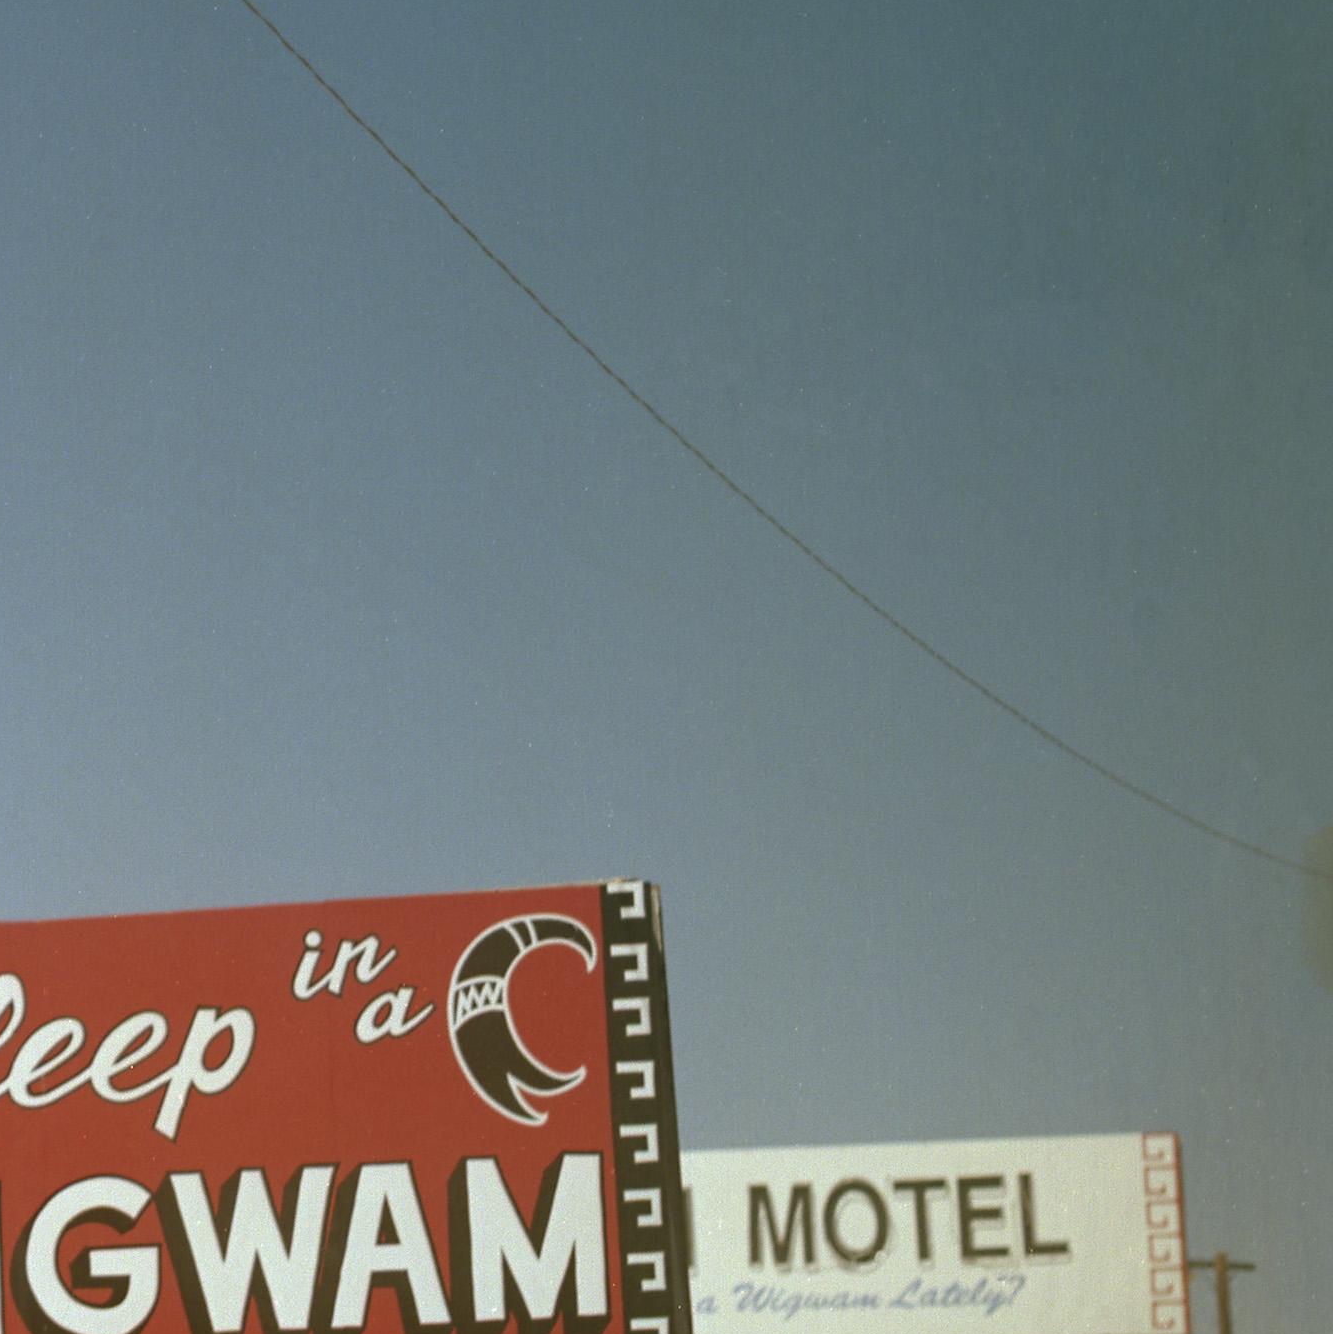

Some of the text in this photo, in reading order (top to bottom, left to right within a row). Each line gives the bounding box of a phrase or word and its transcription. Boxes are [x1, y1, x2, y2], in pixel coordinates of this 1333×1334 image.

[291, 928, 397, 998] in
[354, 983, 434, 1045] a
[747, 1172, 1069, 1266] MOTEL
[732, 1280, 880, 1321] Wigwam
